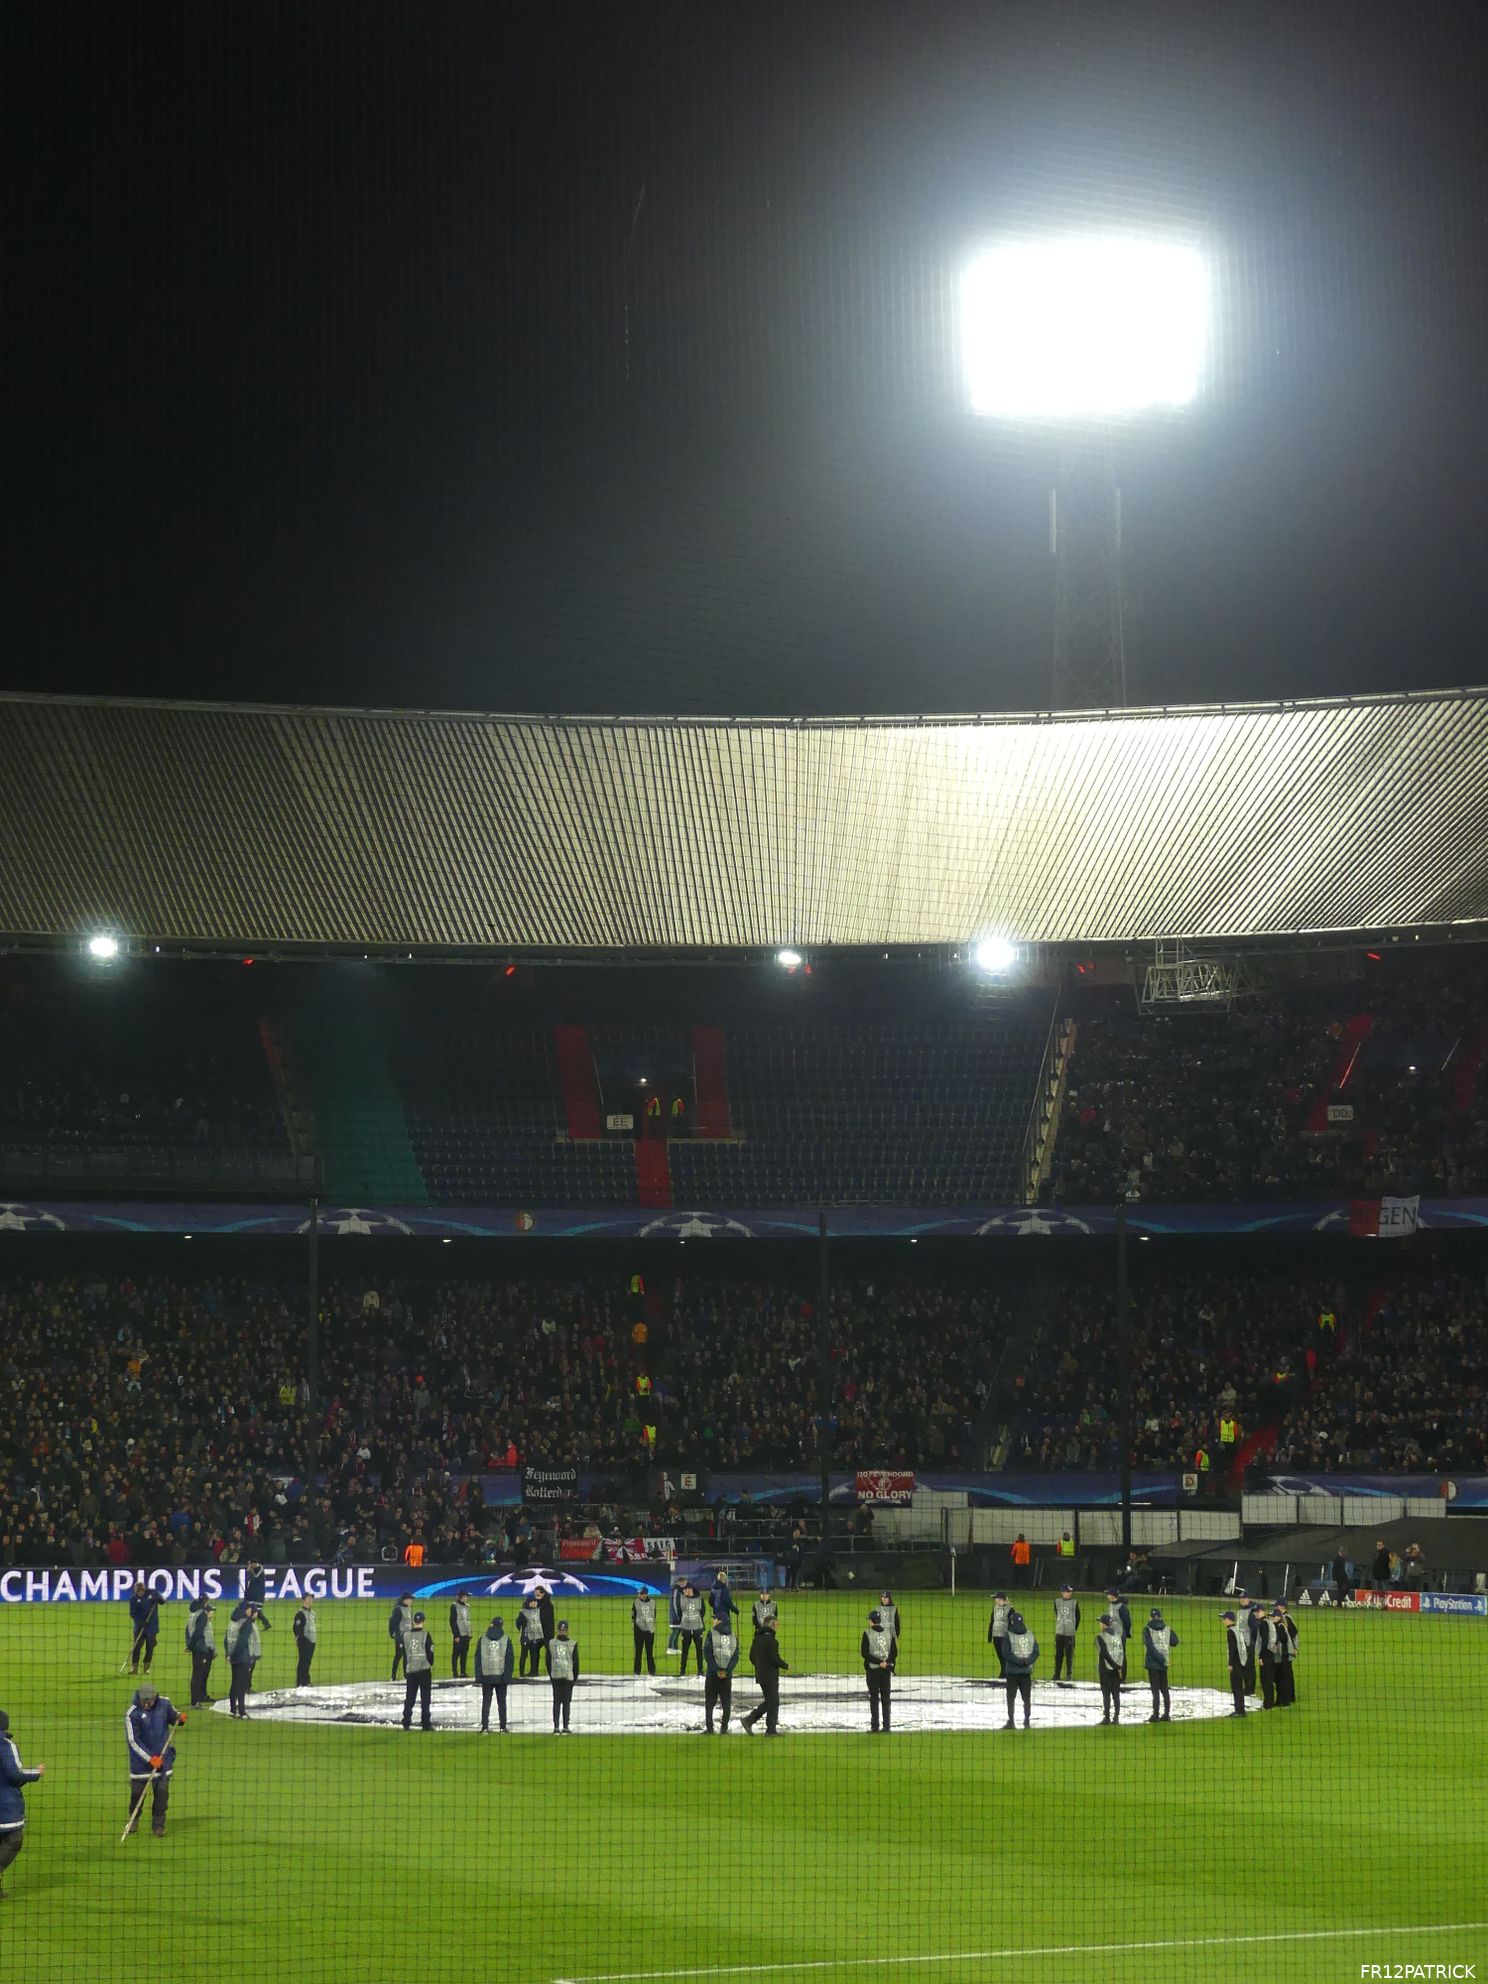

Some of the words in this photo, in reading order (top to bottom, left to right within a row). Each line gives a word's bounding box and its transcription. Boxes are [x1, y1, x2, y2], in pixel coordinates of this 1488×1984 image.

[857, 1490, 874, 1500] NO
[875, 1490, 913, 1500] GLORY
[238, 1567, 375, 1599] LEAGUE
[1433, 1597, 1473, 1613] PlayStation
